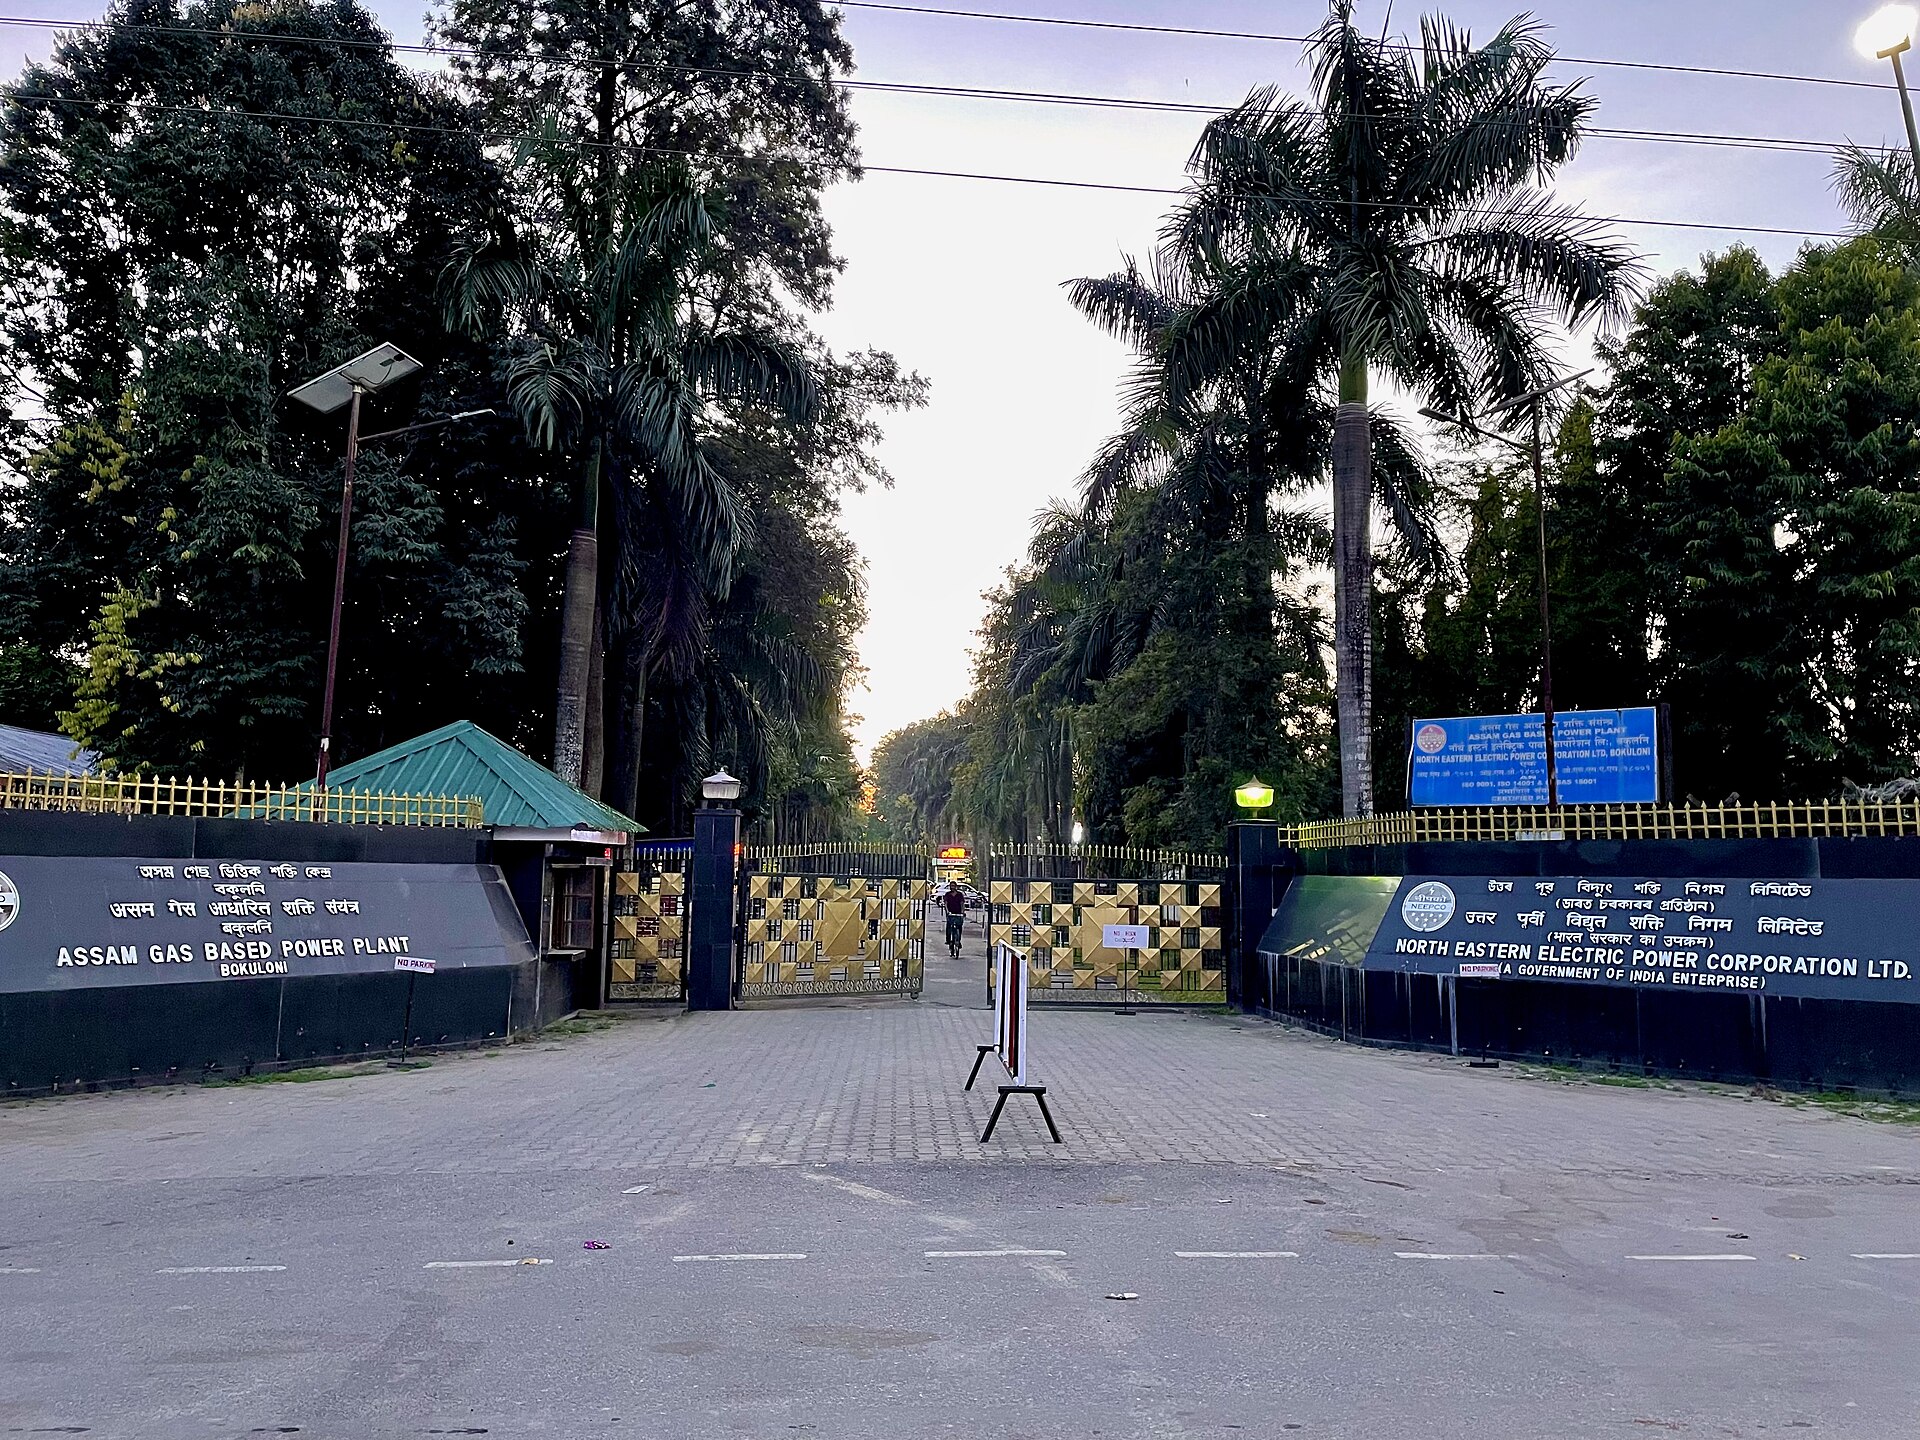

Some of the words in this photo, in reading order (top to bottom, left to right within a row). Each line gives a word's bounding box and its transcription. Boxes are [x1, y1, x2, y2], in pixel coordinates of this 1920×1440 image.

[1557, 728, 1592, 736] POWER
[1594, 726, 1626, 734] PLANT
[1416, 756, 1440, 764] NORTH
[1441, 754, 1473, 763] EASTERN
[1475, 753, 1508, 762] ELECTRIC
[1510, 752, 1536, 760] POWER
[1610, 747, 1651, 757] BOKULONI
[140, 866, 174, 878] অসম
[269, 863, 297, 878] শক্তি
[1633, 881, 1662, 894] শক্তি
[1685, 881, 1726, 895] নিগম
[1750, 881, 1812, 897] লিমিটেড
[109, 902, 155, 918] असम
[208, 899, 271, 917] आधारित
[281, 898, 316, 916] शक्ति
[325, 898, 360, 915] संयंत्र
[1411, 903, 1447, 911] NEEPCO
[221, 919, 273, 938] बकुलनि
[1465, 911, 1498, 925] उत्तर
[1516, 911, 1547, 929] पूर्वी
[1566, 911, 1608, 932] विद्युत
[1629, 913, 1665, 931] शक्ति
[1688, 915, 1733, 932] निगम
[1757, 916, 1824, 936] लिमिटेड
[1547, 931, 1583, 945] (भारत
[1589, 933, 1633, 946] सरकार
[1639, 934, 1657, 947] का
[1663, 934, 1714, 949] उपक्रम)
[56, 945, 138, 967] ASSAM
[149, 944, 194, 964] GAS
[204, 941, 272, 962] BASED
[281, 938, 345, 958] POWER
[352, 936, 409, 955] PLANT
[1395, 938, 1449, 956] NORTH
[1454, 941, 1531, 960] EASTERN
[1537, 945, 1625, 965] ELECTRIC
[1632, 949, 1699, 969] POWER
[1706, 953, 1858, 977] CORPORATION
[1867, 959, 1913, 980] LTD.
[220, 960, 289, 977] BOKULONI
[1498, 961, 1512, 974] (A
[1518, 963, 1600, 980] GOVERNMENT
[1605, 967, 1625, 981] OF
[1629, 969, 1665, 984] INDIA
[1672, 972, 1766, 989] ENTERPRISE)
